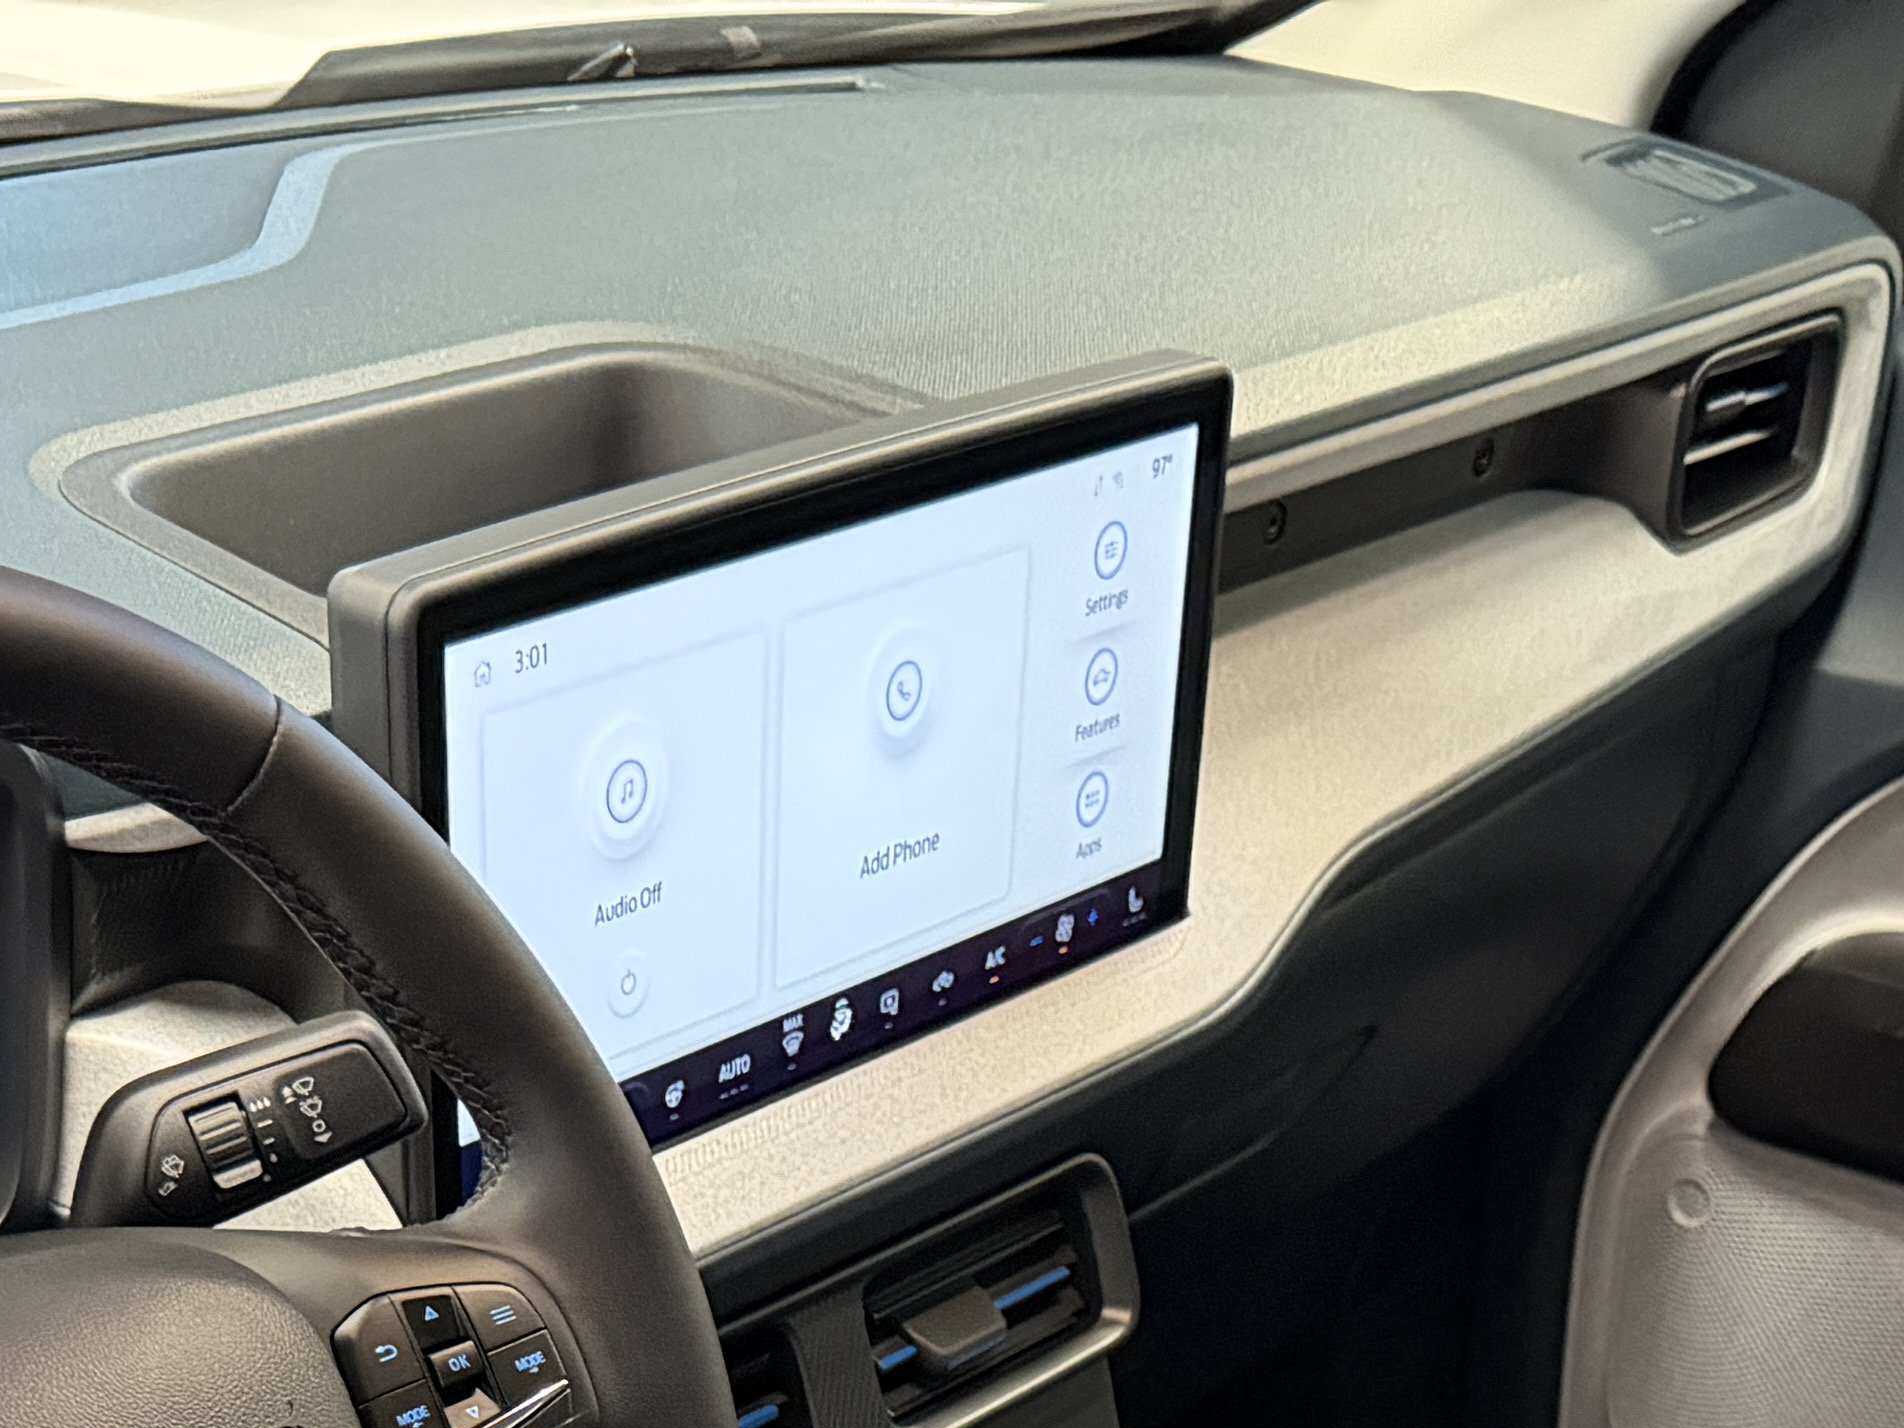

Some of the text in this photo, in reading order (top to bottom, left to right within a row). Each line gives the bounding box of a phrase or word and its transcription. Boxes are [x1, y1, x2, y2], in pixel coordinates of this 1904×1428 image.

[1084, 589, 1129, 617] Settings
[514, 643, 549, 674] 3:01
[1074, 712, 1121, 742] Features
[860, 832, 941, 879] Add Phone
[1076, 837, 1103, 860] Apps
[594, 881, 663, 926] Audio Off
[718, 1055, 751, 1083] AUTO
[448, 1354, 472, 1373] OK
[514, 1351, 546, 1372] MODE
[396, 1405, 430, 1427] MODE
